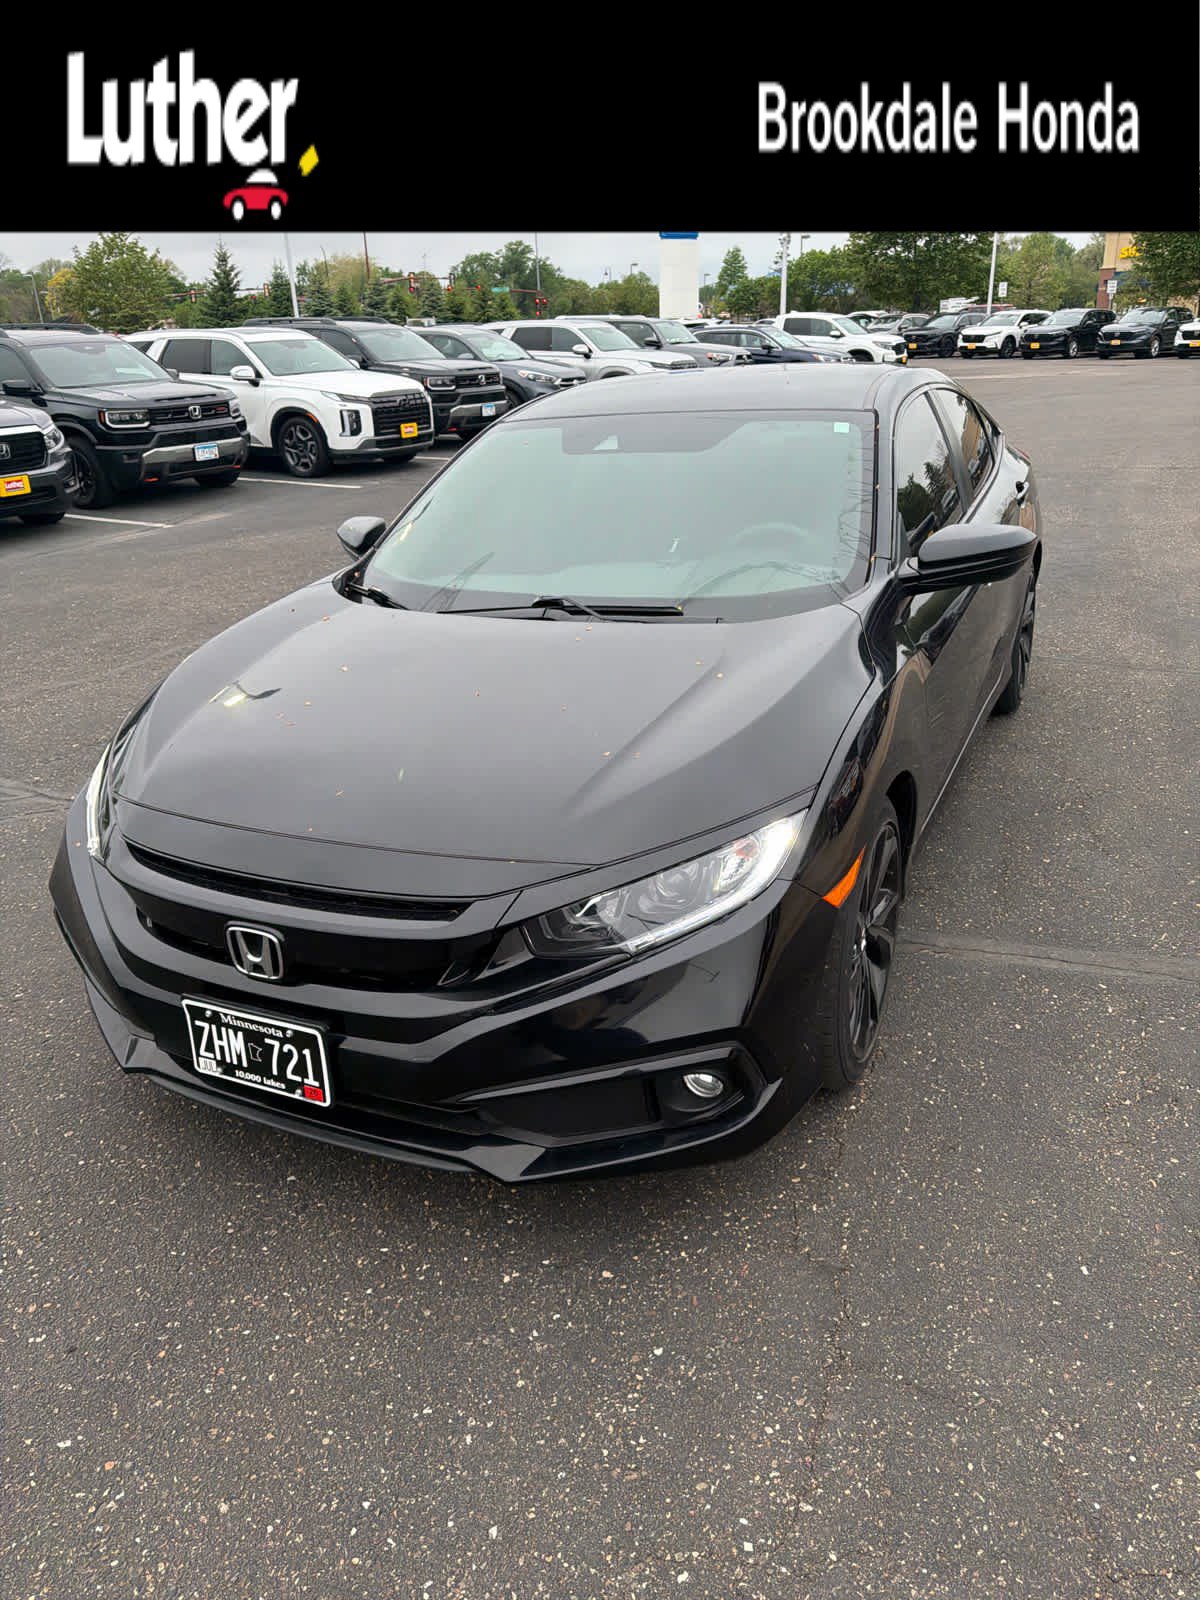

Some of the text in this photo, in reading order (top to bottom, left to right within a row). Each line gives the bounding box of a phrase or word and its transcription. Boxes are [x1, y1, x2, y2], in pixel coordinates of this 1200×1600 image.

[218, 1012, 284, 1038] Minnesota
[194, 1019, 320, 1087] ZHM 721
[234, 1069, 262, 1083] 10,000
